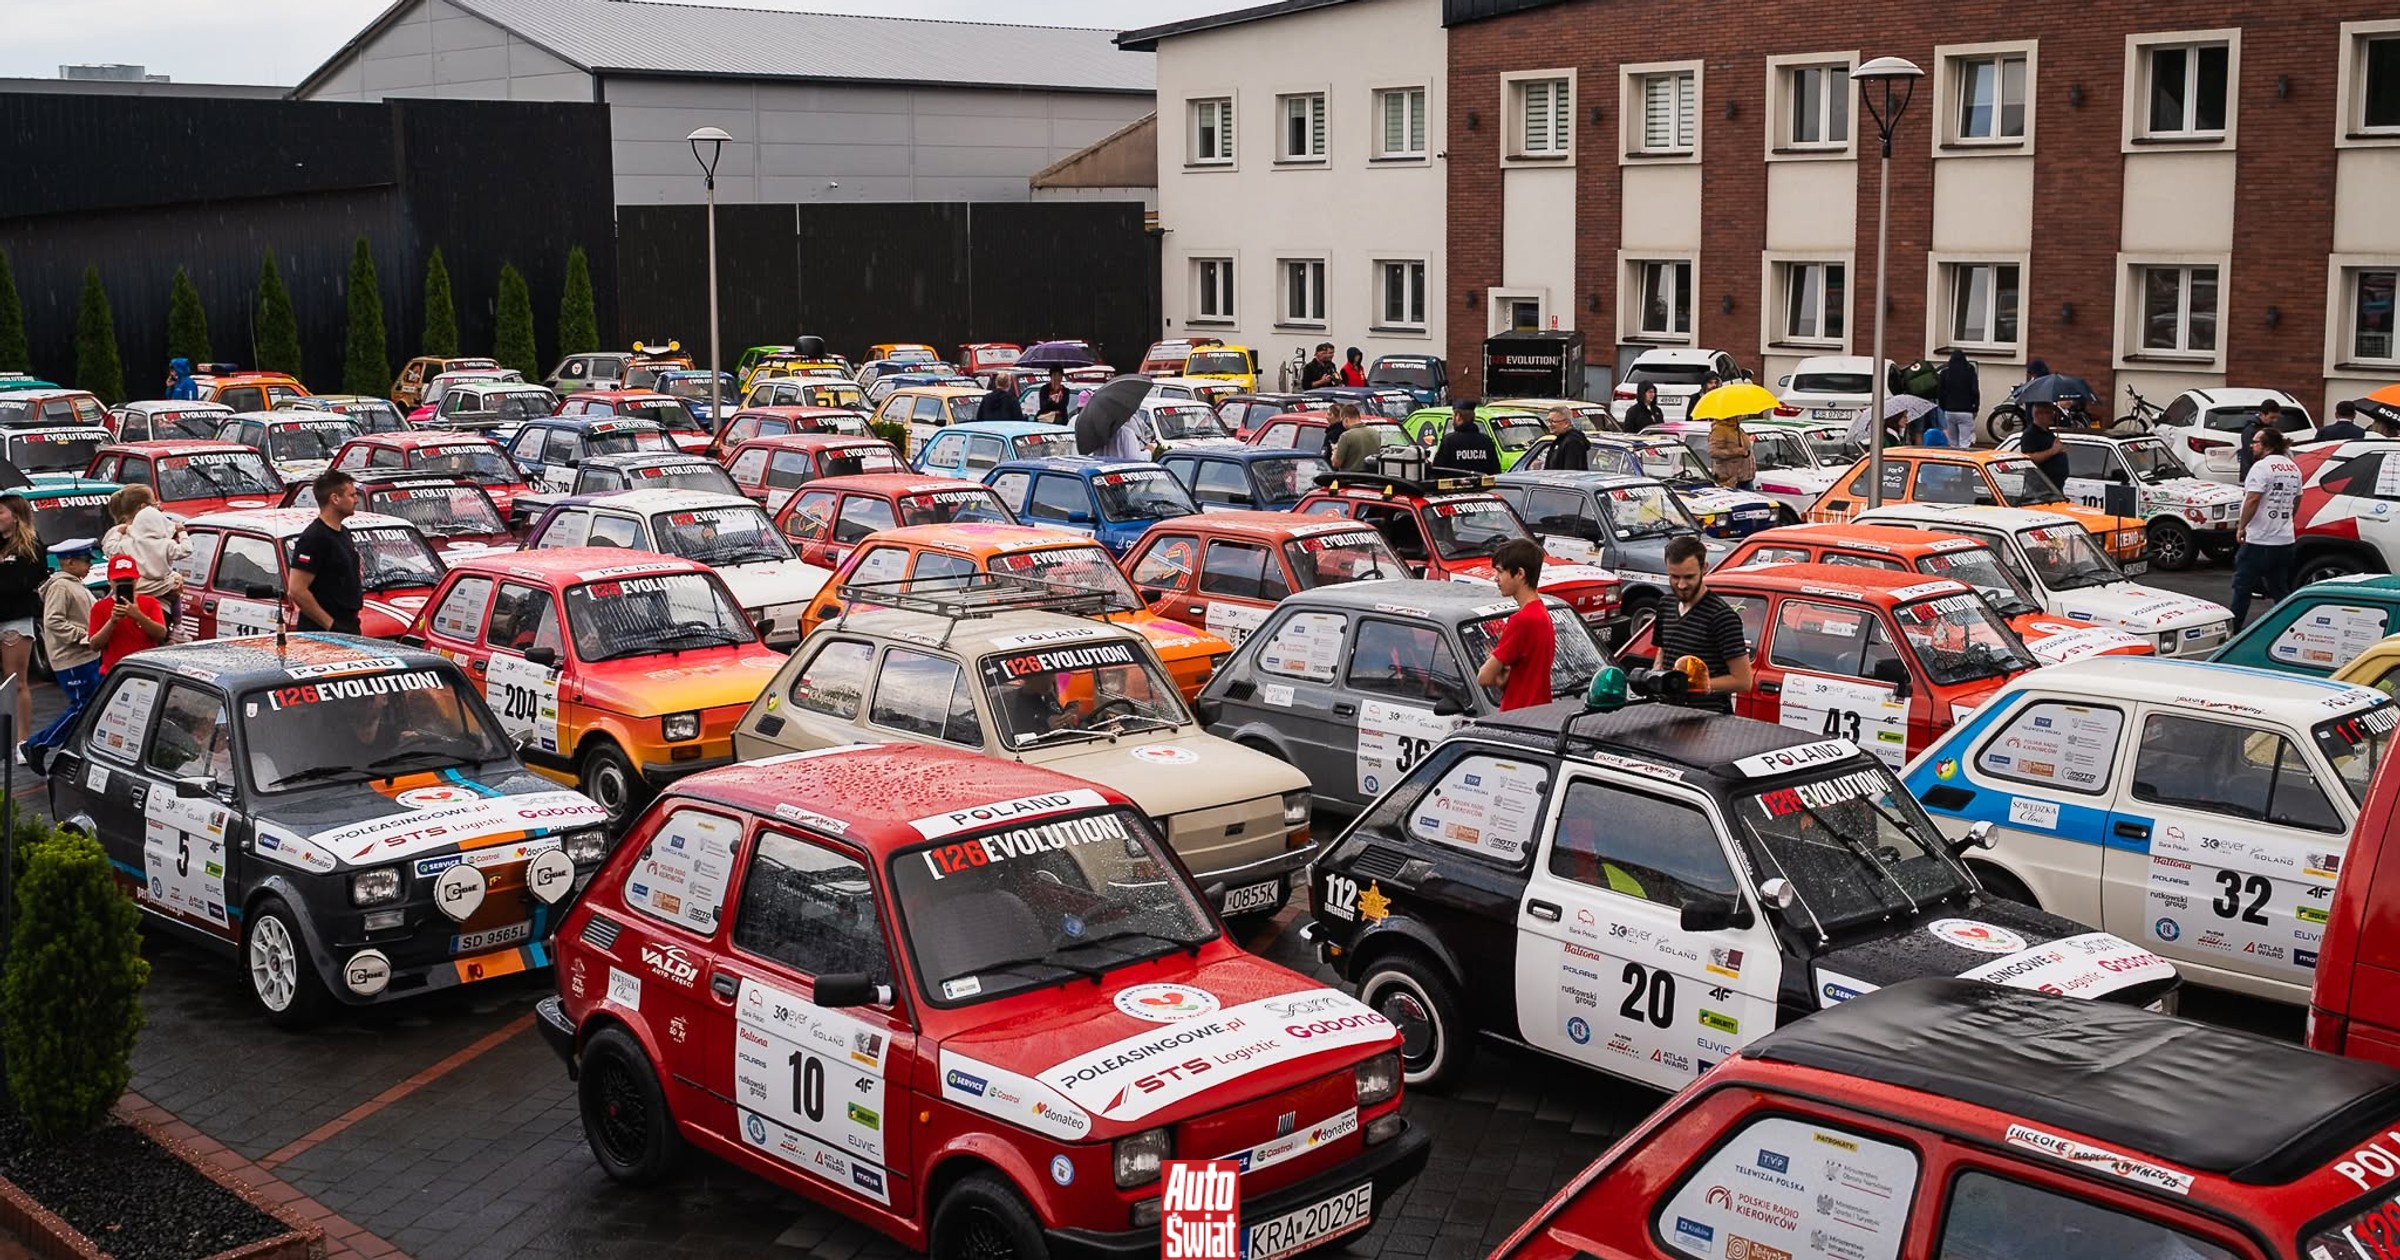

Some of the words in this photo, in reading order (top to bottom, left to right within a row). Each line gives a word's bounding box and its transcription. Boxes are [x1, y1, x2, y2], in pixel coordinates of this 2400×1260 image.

[1456, 449, 1487, 460] POLICJA
[2271, 464, 2297, 472] POLAN
[2082, 495, 2104, 509] 101
[1489, 601, 1515, 611] POL
[1015, 628, 1094, 643] POLAND
[294, 659, 397, 677] POLAND
[1001, 645, 1134, 679] [126EVOLUTION]
[267, 671, 444, 710] [126EVOLUTION]
[505, 683, 537, 723] 204
[1823, 708, 1861, 745] 43
[1884, 716, 1898, 724] 4F
[1762, 742, 1841, 771] POLAND
[1755, 769, 1890, 819] [126EVOLUTION]
[950, 793, 1072, 826] POLAND
[2013, 801, 2057, 815] SZWEDZKA
[332, 804, 490, 842] POLEASINGOWE.pl
[2020, 811, 2043, 823] Clinic
[384, 826, 447, 847] STS
[452, 817, 507, 832] Logistic
[176, 829, 189, 877] 5
[922, 813, 1129, 880] [126EVOLUTION]
[429, 860, 461, 870] SERVICE
[475, 853, 500, 862] Castrol
[2153, 856, 2191, 870] Baltona
[2152, 874, 2190, 886] POLARIS
[1233, 882, 1277, 909] 0855K
[1326, 873, 1357, 912] 112
[2150, 892, 2188, 904] rutkowski
[2212, 869, 2272, 926] 32
[2307, 886, 2332, 899] 4F
[1324, 902, 1354, 922] EMERGENCY
[2165, 900, 2187, 910] group
[462, 934, 483, 949] SD
[487, 925, 528, 946] 9565L
[2294, 930, 2321, 941] EUVI
[1564, 942, 1600, 962] Baltona
[2258, 942, 2283, 953] ATLAS
[2258, 949, 2284, 959] WARD
[641, 947, 699, 982] VALDI
[2299, 954, 2316, 963] mo
[652, 967, 668, 980] AUTO
[1562, 965, 1598, 980] POLARIS
[2063, 972, 2105, 990] Logistic
[1561, 985, 1597, 1000] rutkowski
[1620, 961, 1676, 1029] 20
[1708, 986, 1734, 1001] 4F
[1836, 989, 1857, 1000] SERV
[1575, 995, 1597, 1008] group
[740, 1028, 768, 1047] Baltona
[739, 1052, 767, 1068] POLARIS
[1061, 1016, 1246, 1090] POLEASINGOWE.pl
[1663, 1051, 1689, 1064] ATLAS
[1134, 1057, 1212, 1094] STS
[1214, 1040, 1281, 1065] Logistic
[1663, 1059, 1689, 1071] WARD
[739, 1075, 767, 1091] rutkowski
[789, 1050, 825, 1122] 10
[855, 1077, 874, 1093] 4F
[956, 1076, 985, 1092] SERVICE
[750, 1087, 767, 1100] group
[996, 1089, 1020, 1104] Castrol
[1044, 1109, 1084, 1130] donateo
[1320, 1118, 1356, 1142] donateo
[1266, 1142, 1293, 1158] Castrol
[824, 1154, 844, 1168] ATLAS
[825, 1163, 846, 1175] WARD
[1762, 1155, 1785, 1168] TVP
[1735, 1164, 1774, 1183] TELEWIZJA
[1775, 1176, 1805, 1193] POLSKA
[1738, 1193, 1772, 1210] POLSKIE
[1773, 1202, 1799, 1219] RADIO
[1251, 1215, 1299, 1259] KRA
[1304, 1187, 1370, 1242] 2029E
[1736, 1203, 1798, 1232] KIEROWCÓW
